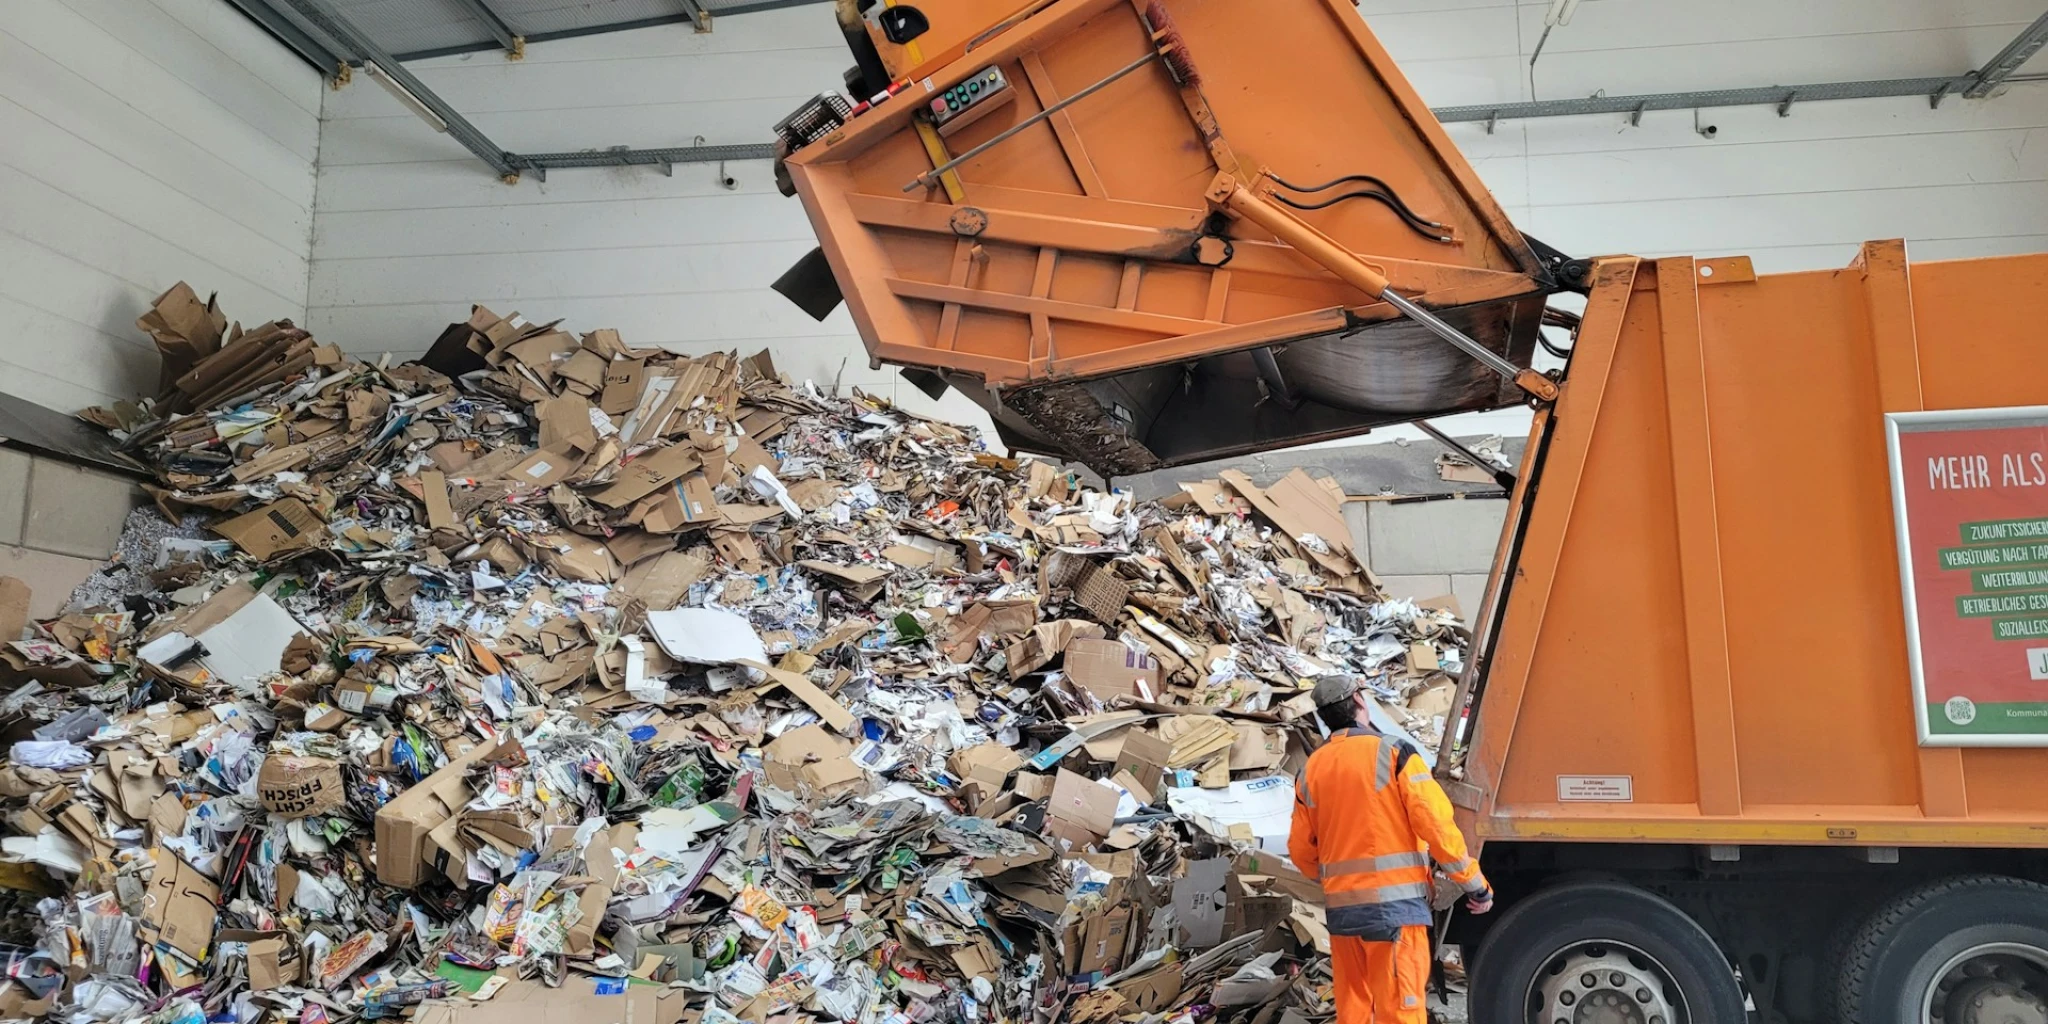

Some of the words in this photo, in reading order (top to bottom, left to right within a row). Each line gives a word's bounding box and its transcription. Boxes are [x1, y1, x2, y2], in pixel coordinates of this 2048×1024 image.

[1928, 455, 1991, 490] MEHR
[2003, 452, 2046, 487] ALS
[1970, 521, 2048, 540] ZUKUNFTSSICHER
[1945, 549, 2000, 566] VERGÜTUNG
[2002, 546, 2028, 562] NACH
[1981, 570, 2048, 588] WEITERBILDUN
[1963, 596, 2027, 614] BETRIEBLICHES
[1999, 619, 2048, 637] SOZIALLEIS
[2040, 653, 2048, 674] J
[275, 797, 315, 813] ECHT
